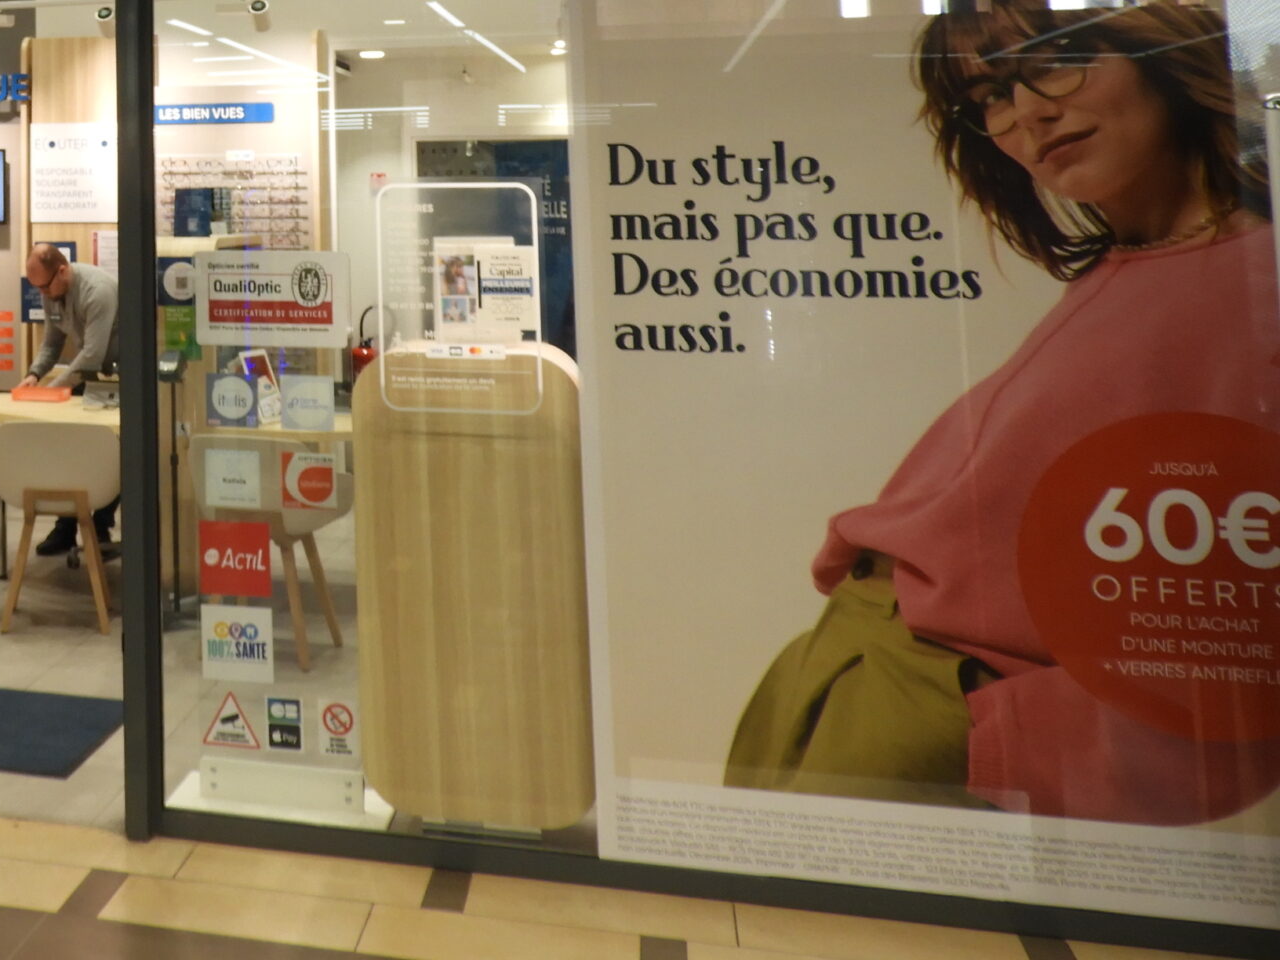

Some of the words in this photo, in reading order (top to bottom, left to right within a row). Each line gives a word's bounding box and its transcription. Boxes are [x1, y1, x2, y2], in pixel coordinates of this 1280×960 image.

[159, 108, 180, 121] LES
[182, 107, 210, 120] BIEN
[211, 106, 245, 120] VUES
[607, 142, 677, 187] Du
[692, 141, 836, 202] style,
[610, 199, 720, 243] mais
[734, 210, 818, 258] pas
[832, 210, 944, 258] que.
[489, 267, 523, 279] Capital
[612, 252, 700, 297] Des
[713, 256, 983, 300] économies
[213, 279, 282, 297] QualiOptic
[213, 308, 273, 317] CERTIFICATION
[275, 308, 286, 317] DE
[288, 309, 328, 319] SERVICES
[613, 310, 746, 353] aussi.
[1149, 461, 1219, 477] JUSQU'À
[1084, 487, 1280, 570] 60€
[1129, 611, 1182, 629] POUR
[1187, 615, 1261, 633] L'ACHAT
[207, 639, 234, 657] 100%
[1121, 636, 1176, 654] D'UNE
[1181, 640, 1274, 660] MONTURE
[1103, 662, 1113, 671] +
[1116, 660, 1187, 679] VERRES
[1191, 666, 1280, 686] ANTIREFL
